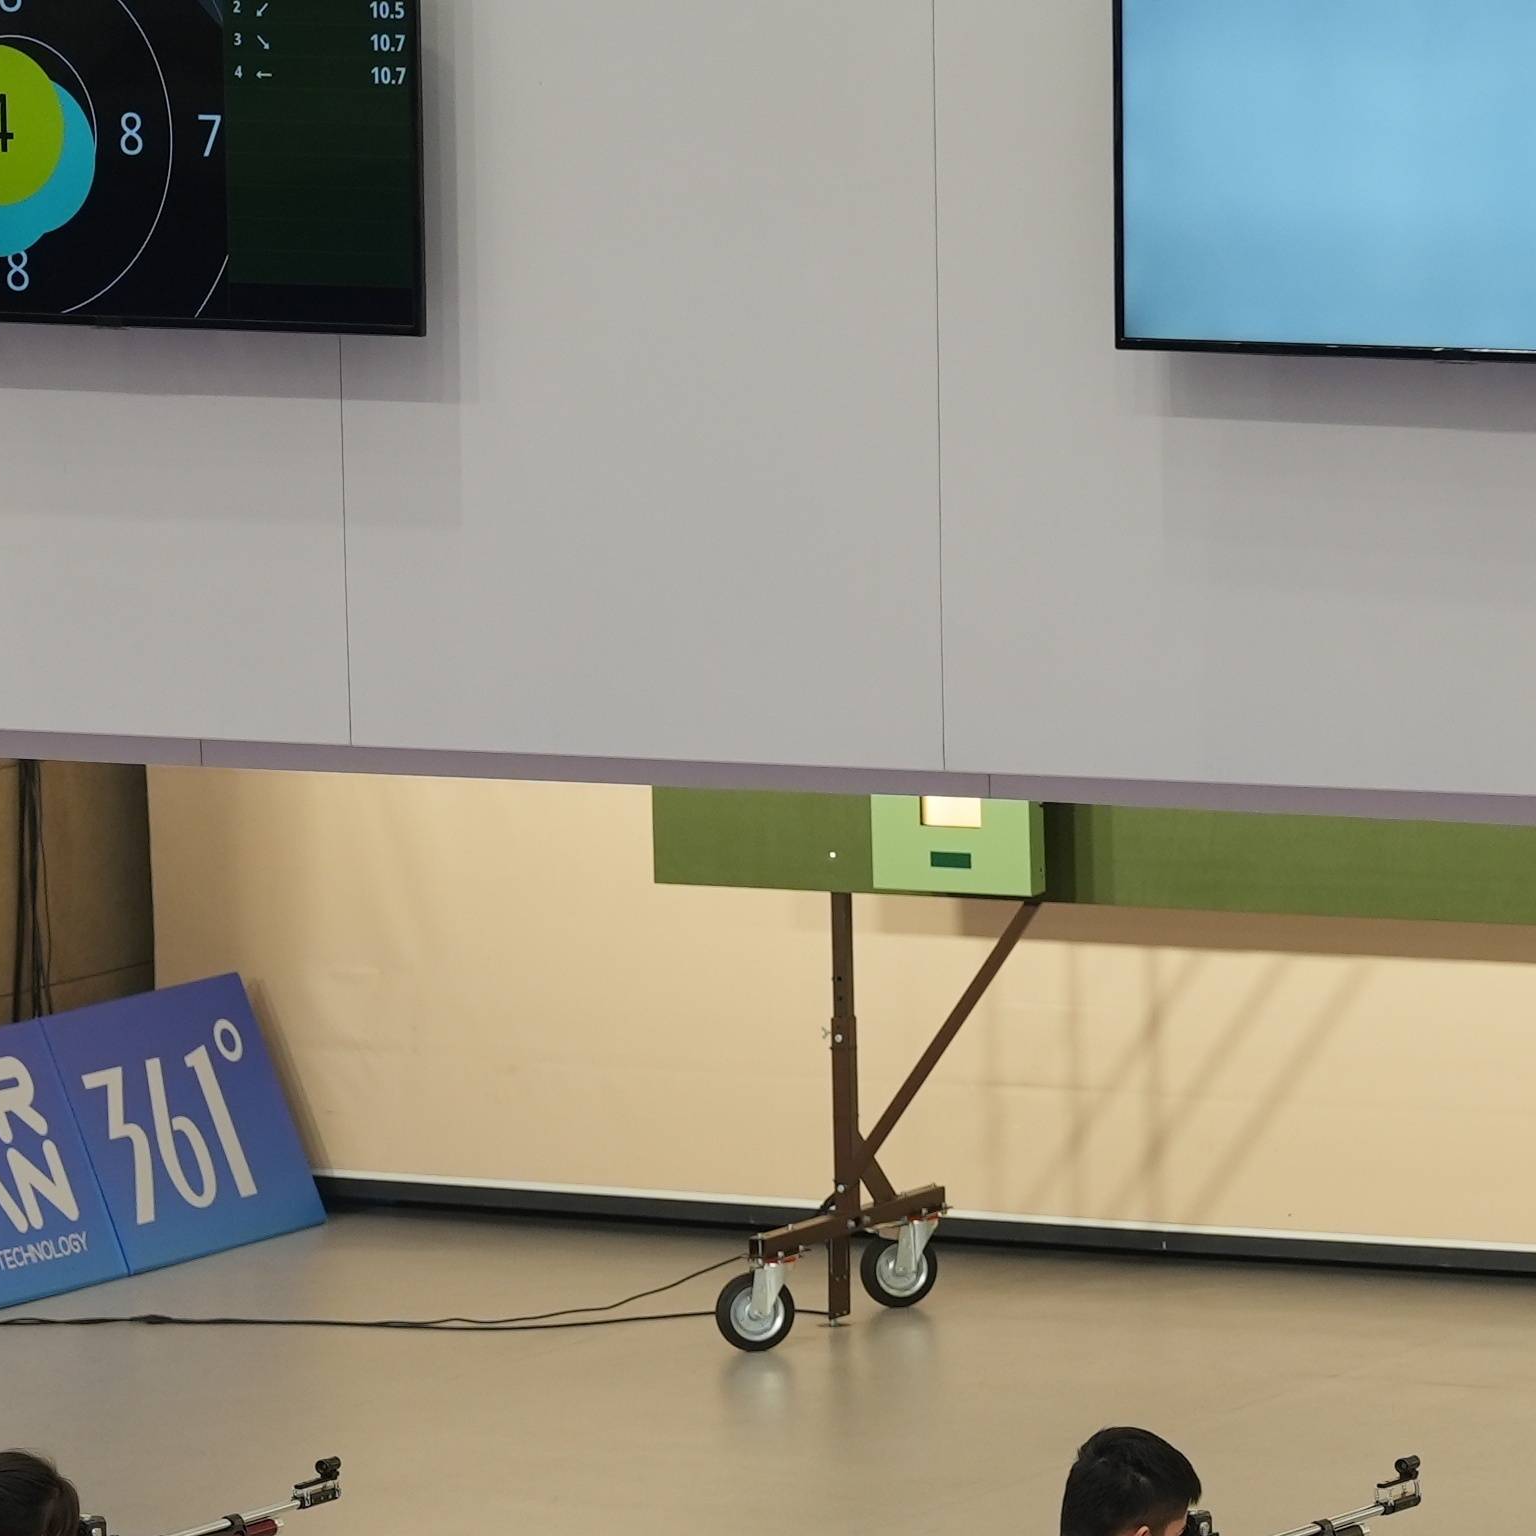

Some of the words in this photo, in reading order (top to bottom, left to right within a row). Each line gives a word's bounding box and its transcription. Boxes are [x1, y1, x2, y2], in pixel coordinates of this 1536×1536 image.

[233, 1, 242, 14] 2
[369, 0, 405, 20] 10.5
[233, 33, 242, 47] 3
[370, 34, 405, 53] 10.7
[234, 66, 243, 80] 4
[370, 67, 407, 86] 10.7
[120, 112, 144, 156] 8
[197, 114, 222, 158] 7
[6, 250, 30, 292] 8
